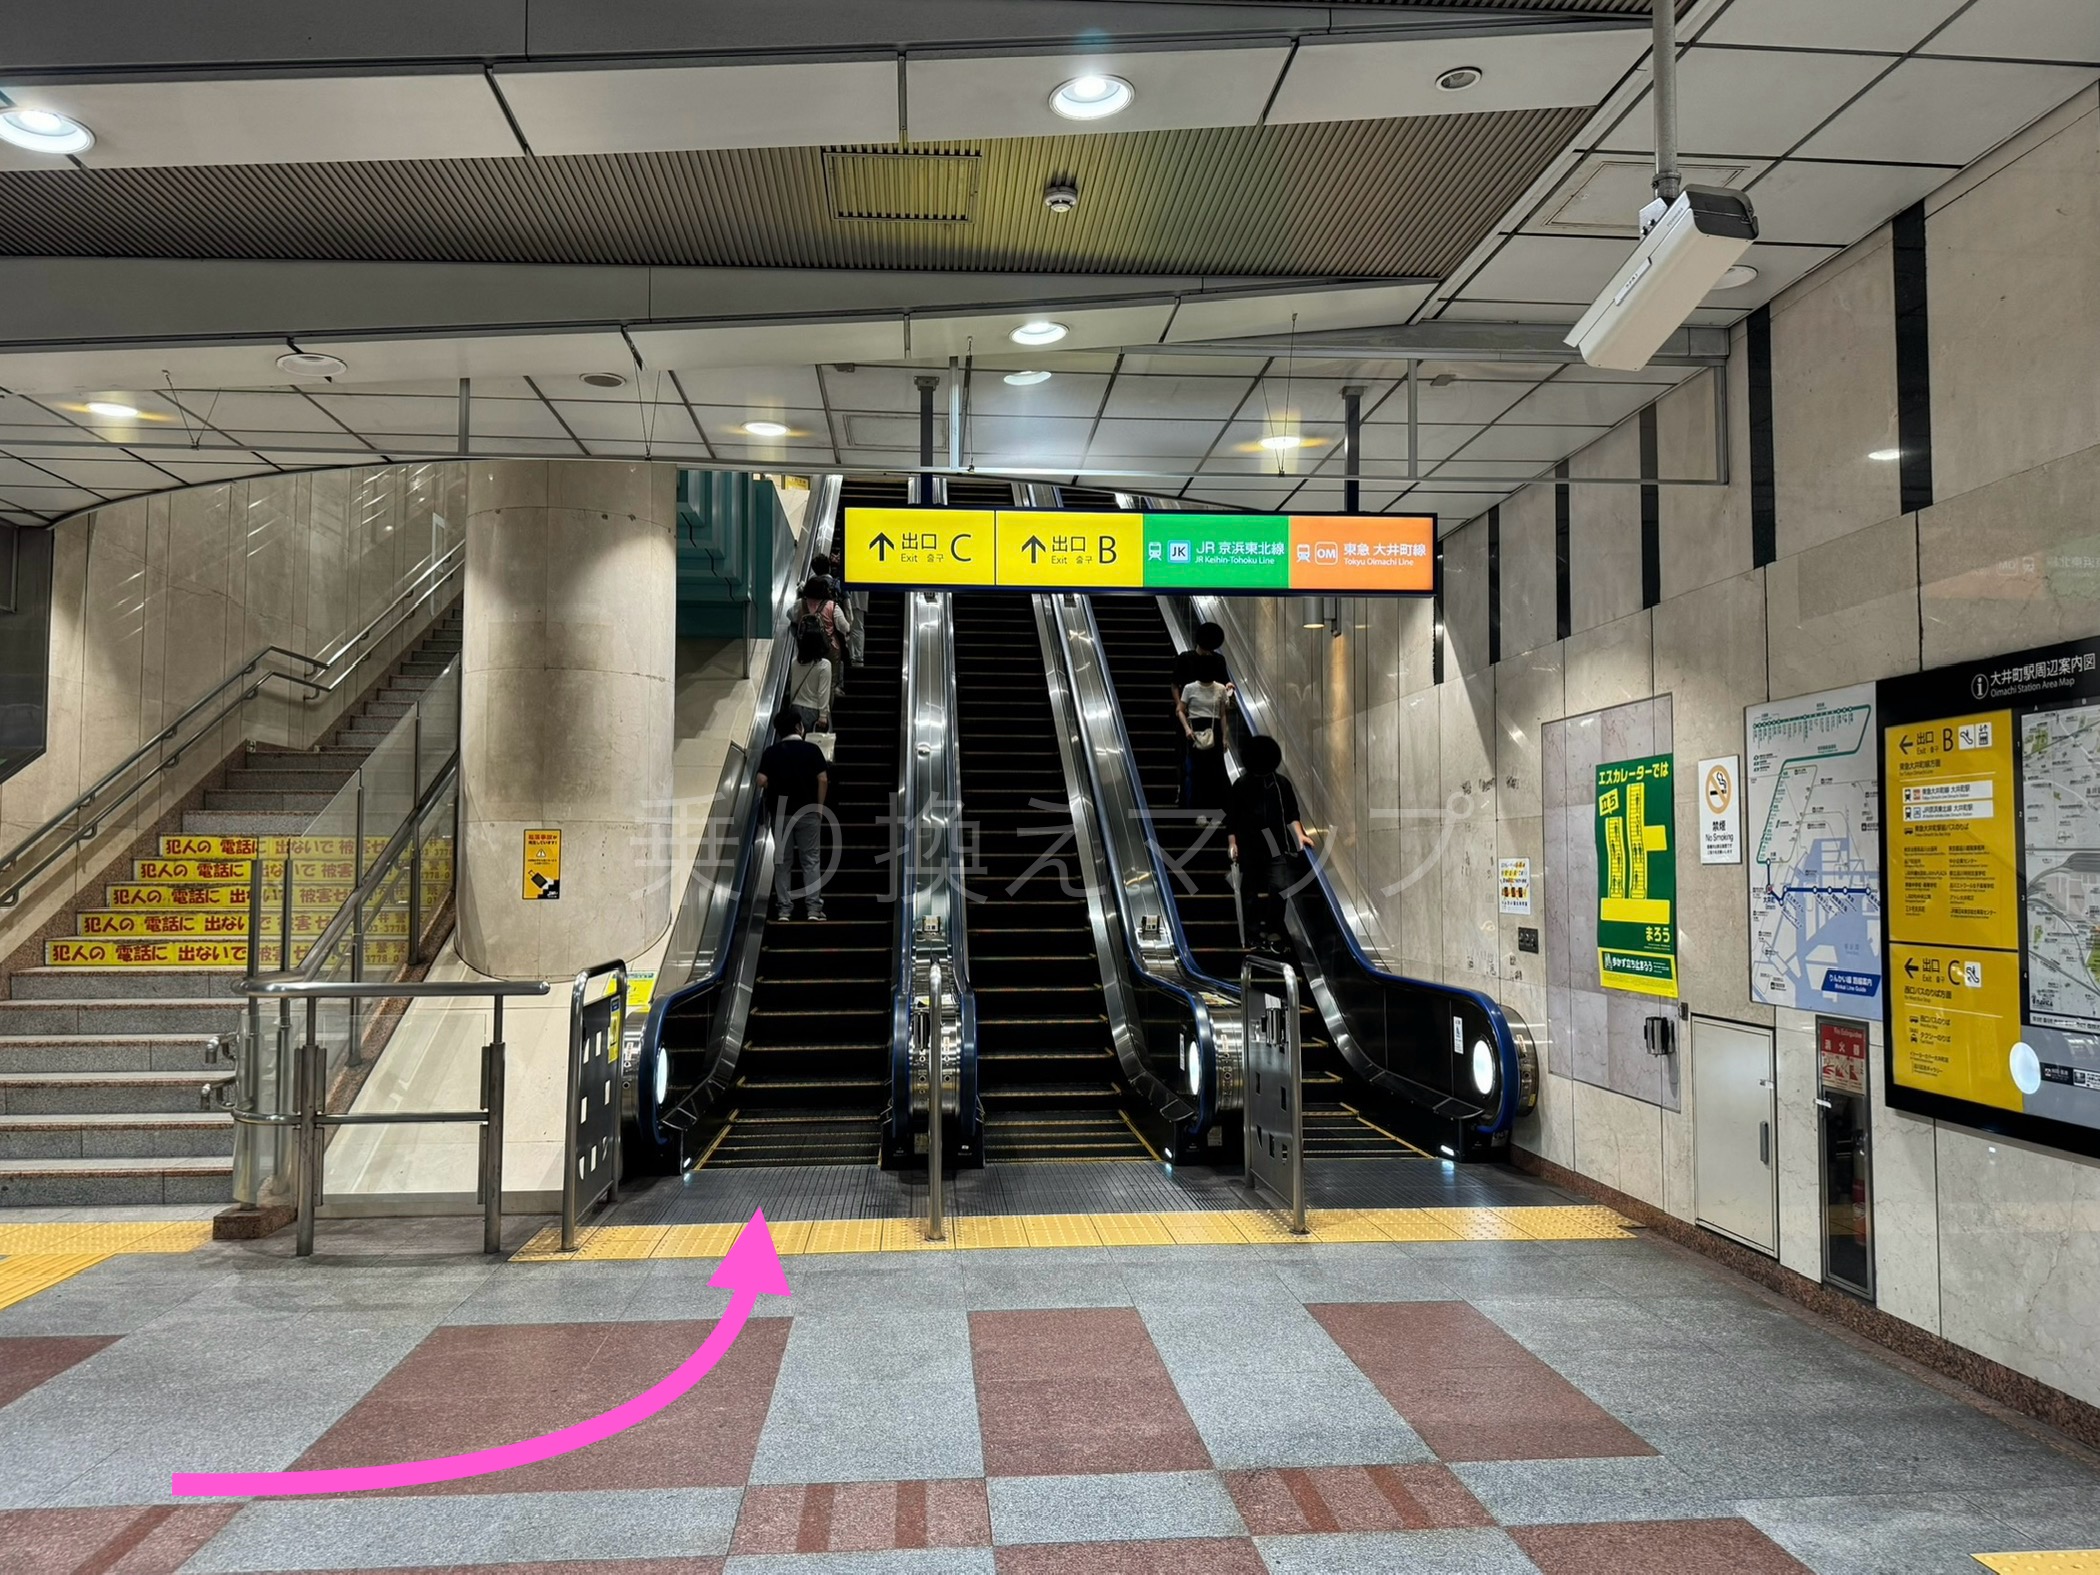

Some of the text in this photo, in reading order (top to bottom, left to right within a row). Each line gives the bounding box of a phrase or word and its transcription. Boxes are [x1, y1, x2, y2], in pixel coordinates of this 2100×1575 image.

[902, 532, 972, 562] 出口 C
[1052, 535, 1117, 564] 出口 B
[1171, 543, 1186, 557] JK
[1196, 541, 1285, 555] JR 京浜東北線
[1317, 547, 1336, 560] OM
[1344, 543, 1427, 556] 東急 大井町線
[901, 553, 918, 563] Exit
[1051, 556, 1068, 565] Exit
[1195, 555, 1275, 565] JR Keihin-Tohoku Line
[1344, 558, 1414, 567] Tokyu Oimachi Line
[1990, 653, 2095, 687] 大井町駅周辺案内図
[1990, 677, 2075, 698] Oimachi Station Area Map
[1916, 728, 1953, 752] 出口 B
[1599, 762, 1669, 785] エスカレーターでは
[1601, 794, 1616, 813] 立ち
[1712, 820, 1726, 831] 禁煙
[1705, 833, 1734, 842] No Smoking
[166, 839, 211, 855] 犯人の
[220, 840, 266, 855] 電話に
[275, 840, 333, 855] 出ないで
[140, 863, 187, 878] 犯人の
[196, 863, 244, 878] 電話に
[113, 889, 161, 904] 犯人の
[171, 889, 220, 904] 電話に
[84, 917, 134, 933] 犯人の
[144, 917, 195, 933] 電話に
[1645, 926, 1670, 943] まろう
[52, 945, 105, 962] 犯人の
[115, 945, 167, 961] 電話に
[178, 944, 247, 961] 出ないで
[1922, 958, 1960, 986] 出口 C
